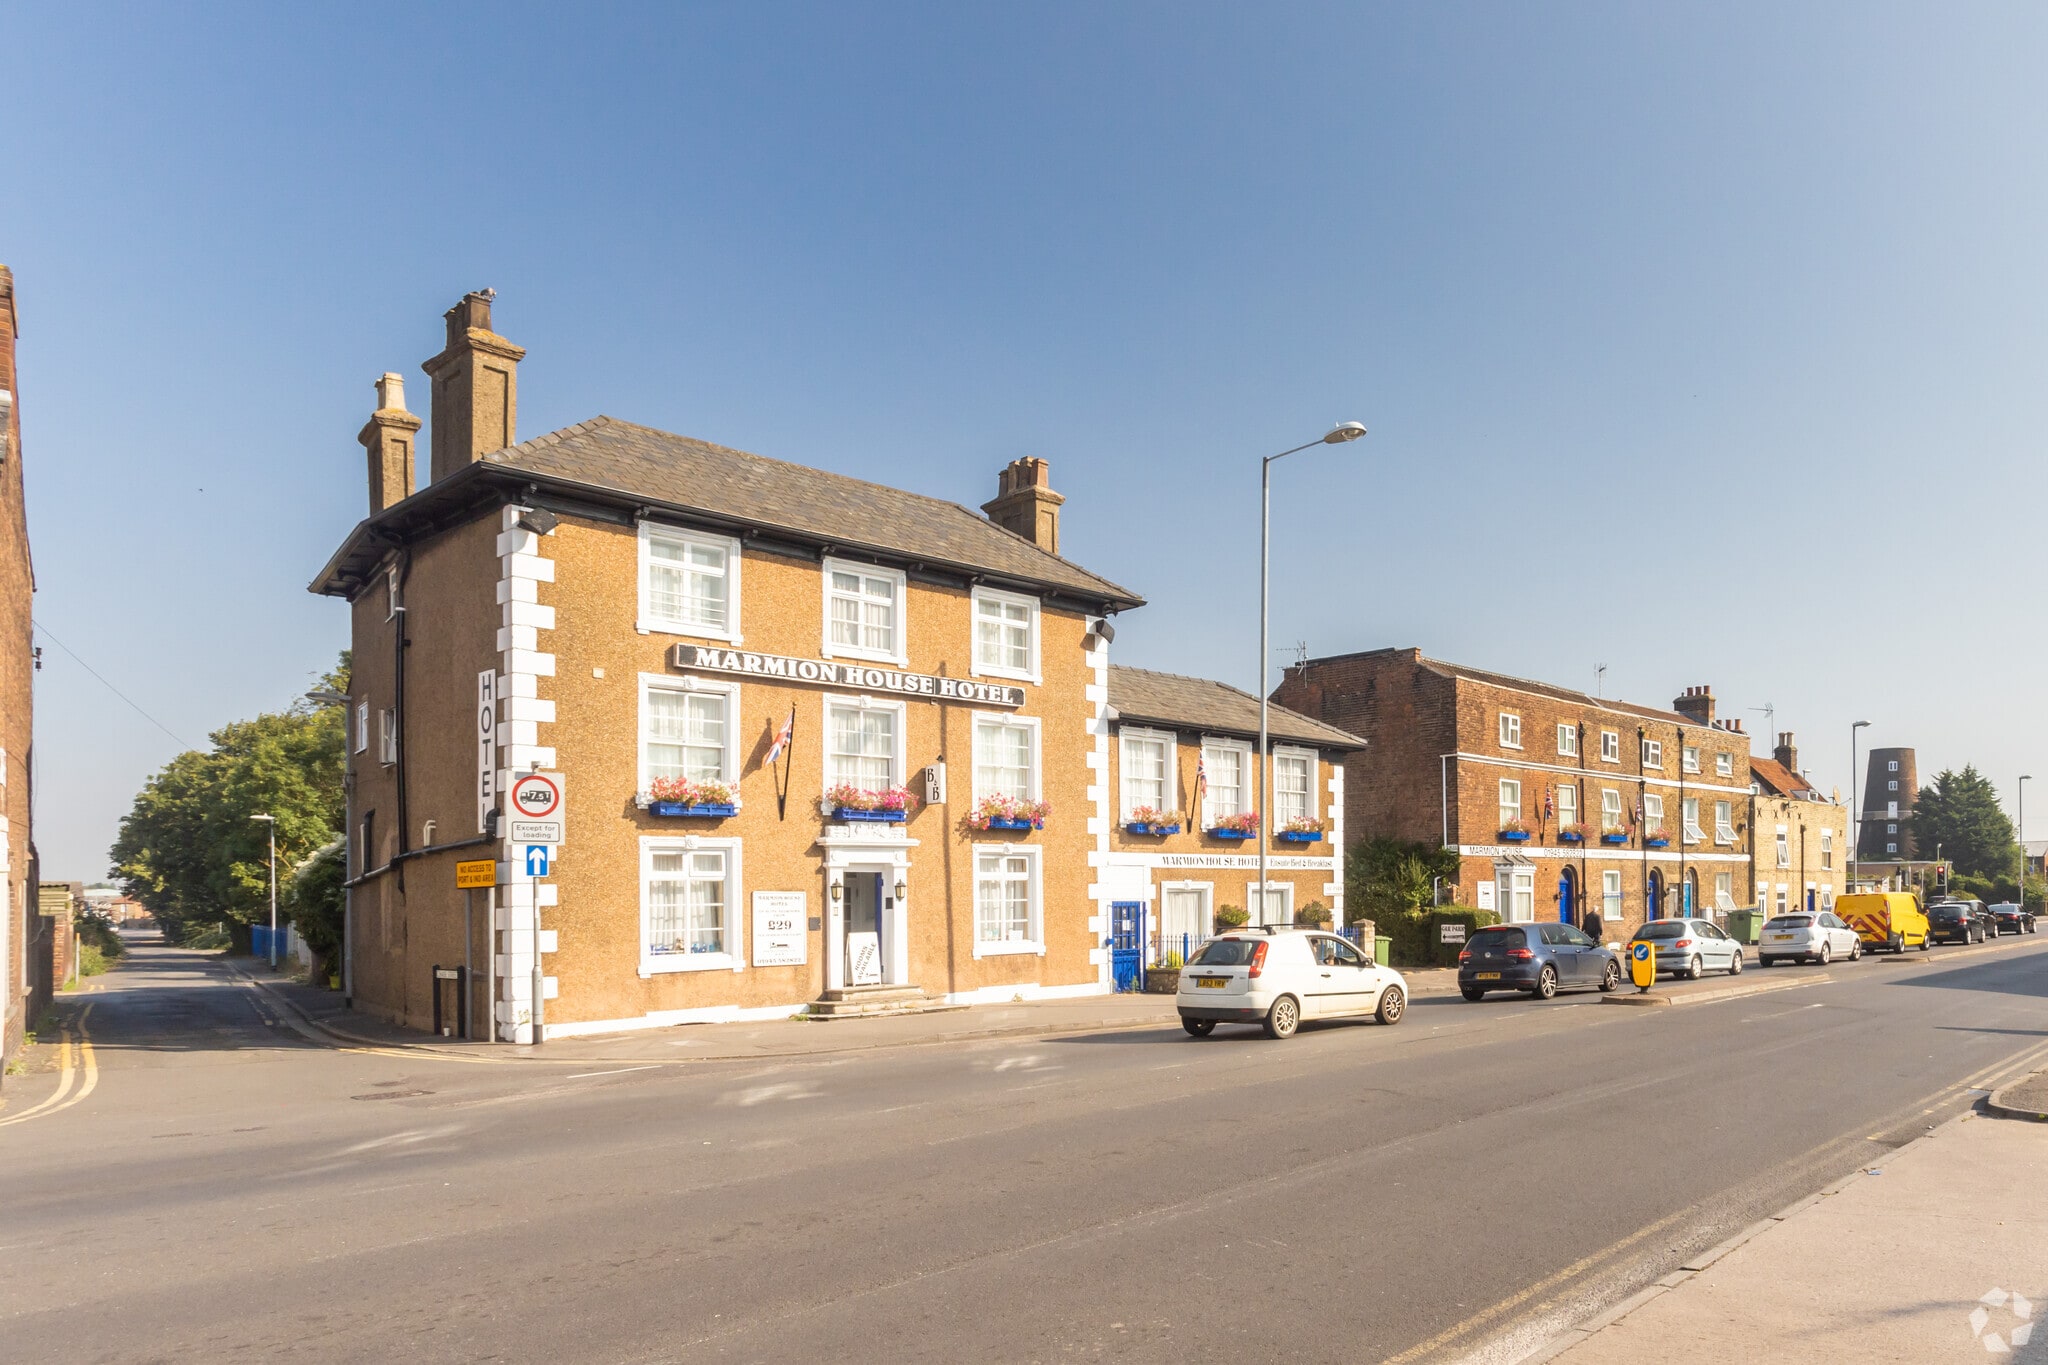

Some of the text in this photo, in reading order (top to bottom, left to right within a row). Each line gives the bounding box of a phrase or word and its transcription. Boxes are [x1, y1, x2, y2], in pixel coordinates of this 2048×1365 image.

[695, 647, 1014, 704] MARMION HOUSE HOTEL
[481, 673, 491, 829] HOTEL
[928, 768, 935, 782] B
[933, 787, 940, 800] B
[516, 824, 542, 832] Except
[1469, 846, 1500, 855] MARMION
[1502, 847, 1523, 856] HOUSE
[1162, 856, 1205, 865] MARMION
[1206, 857, 1236, 866] HOUSE
[1238, 858, 1261, 866] HOTE
[468, 863, 485, 873] ACCESS
[485, 863, 492, 872] TO
[768, 920, 792, 930] £29
